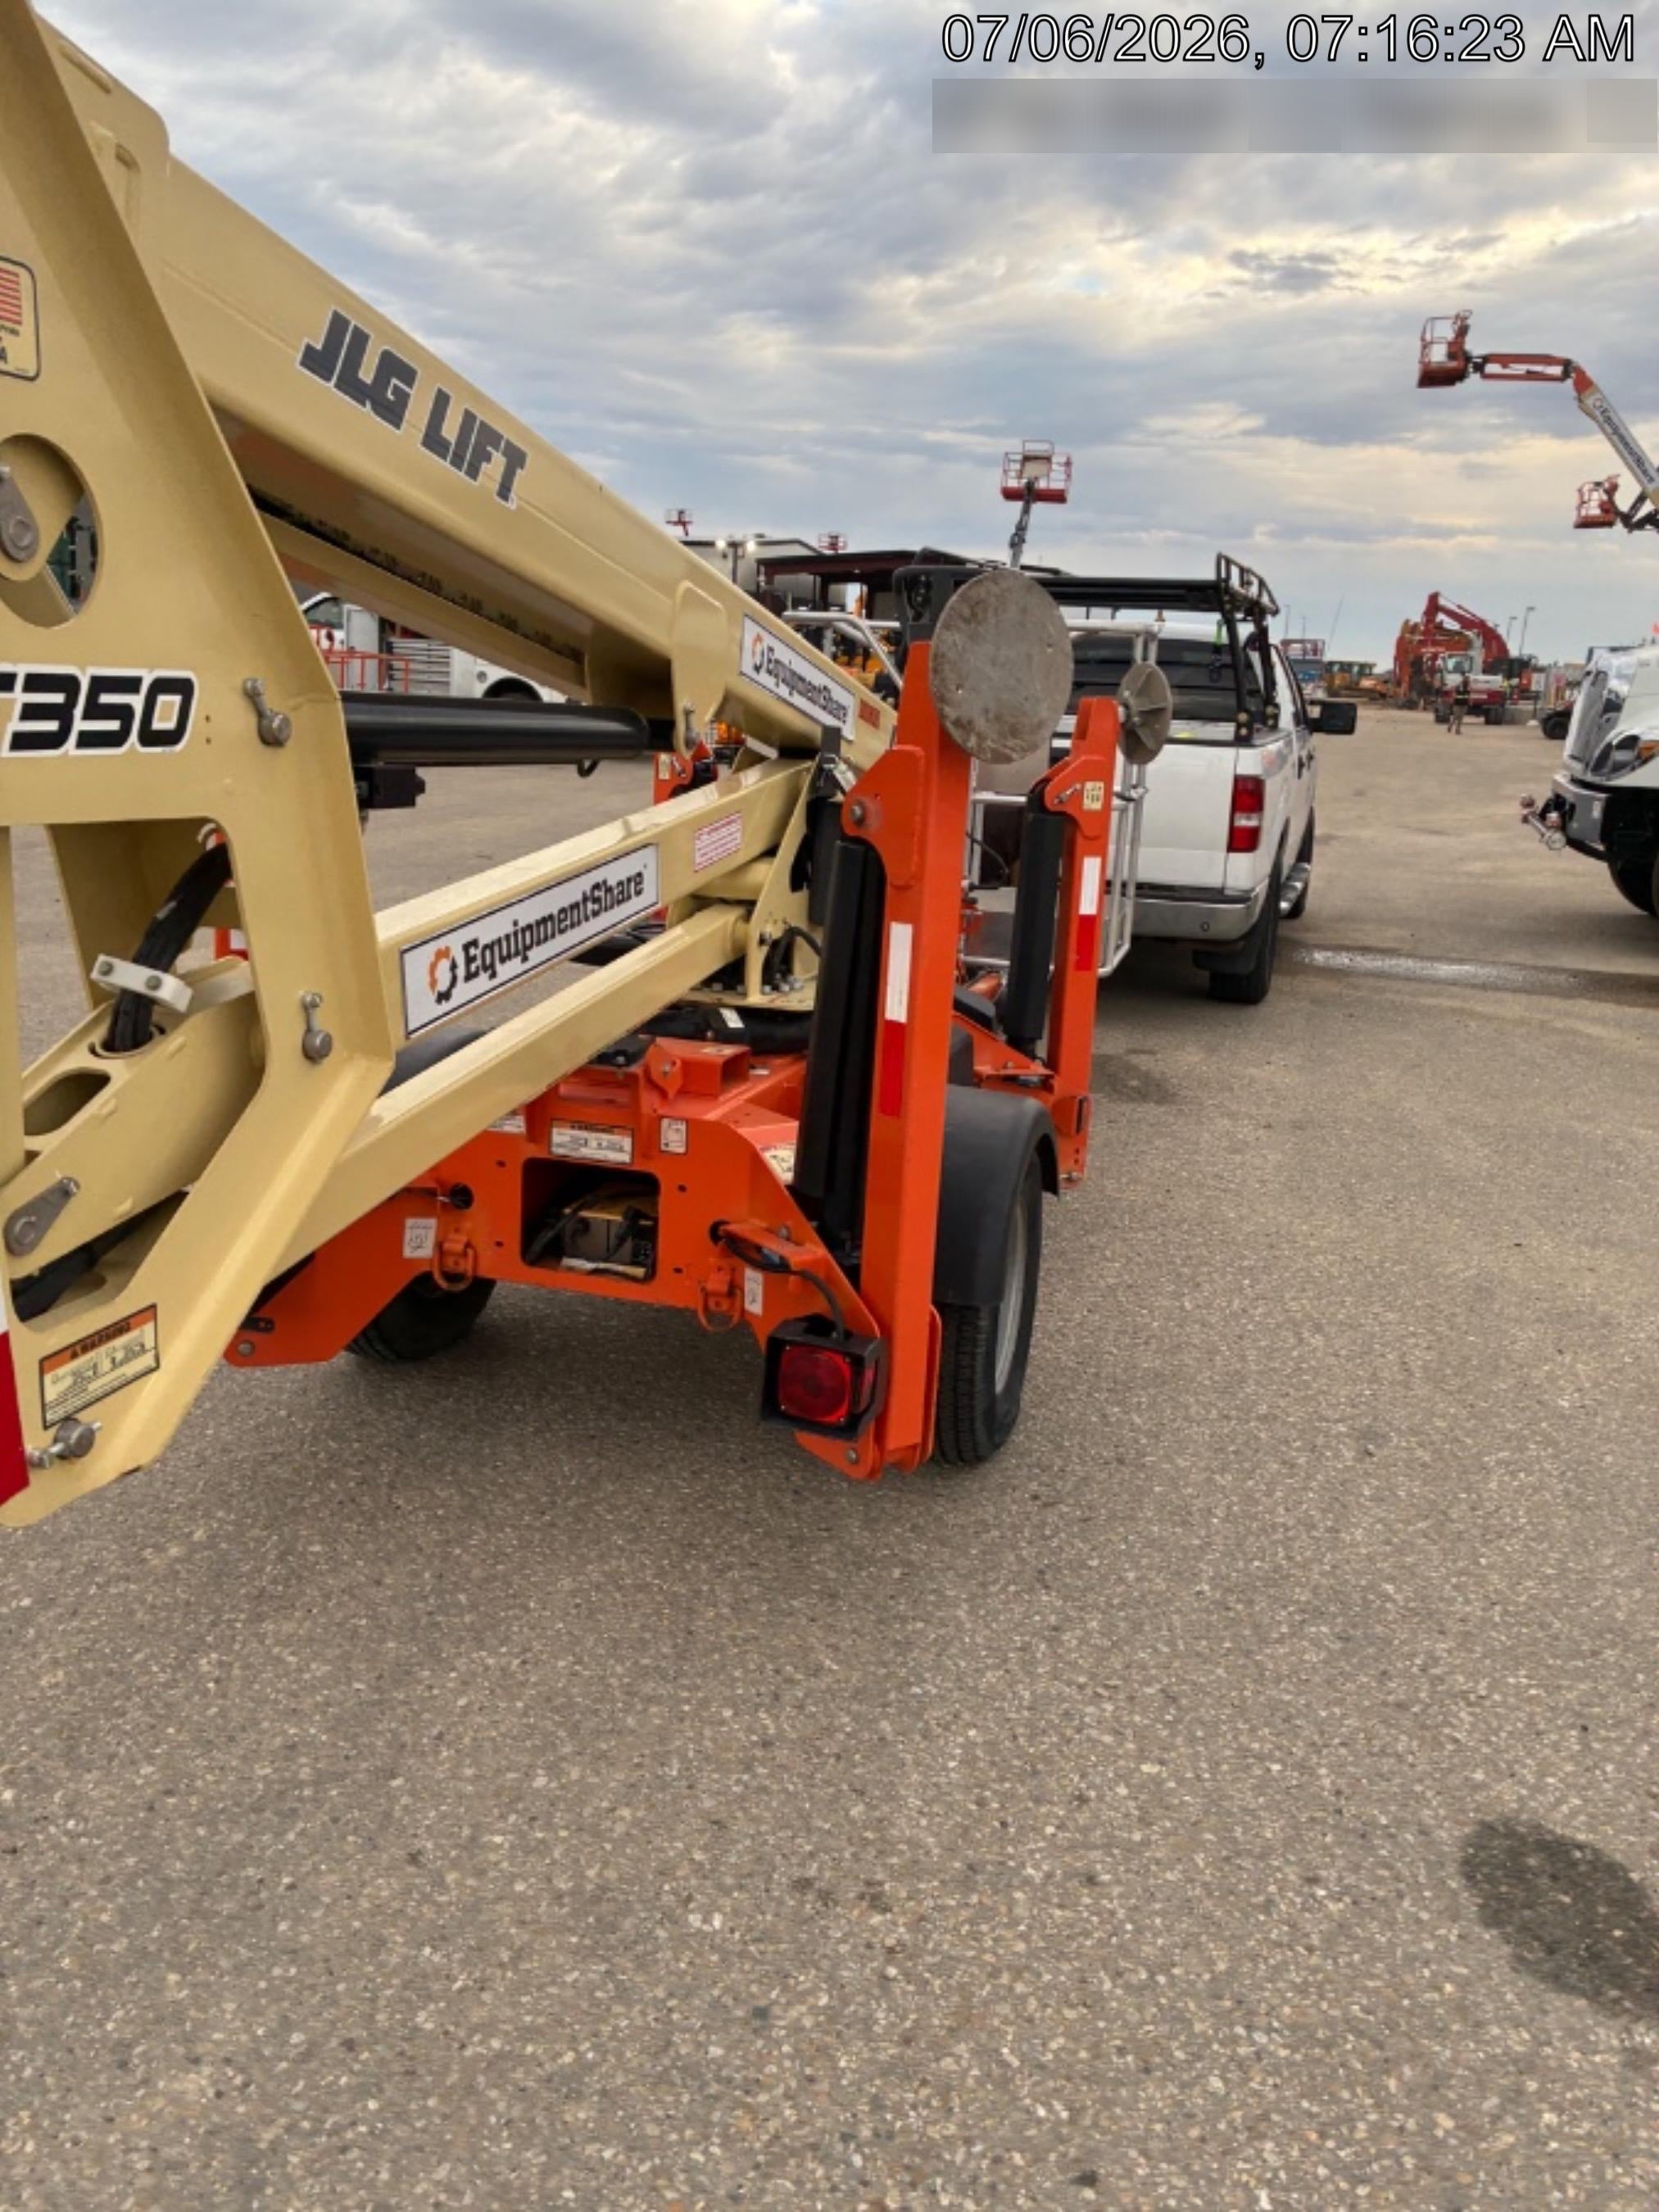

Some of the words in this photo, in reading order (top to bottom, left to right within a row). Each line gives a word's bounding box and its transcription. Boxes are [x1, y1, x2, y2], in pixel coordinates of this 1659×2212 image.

[296, 308, 419, 433] JLG
[419, 385, 529, 504] LIFT
[461, 869, 645, 982] EquipmentShare
